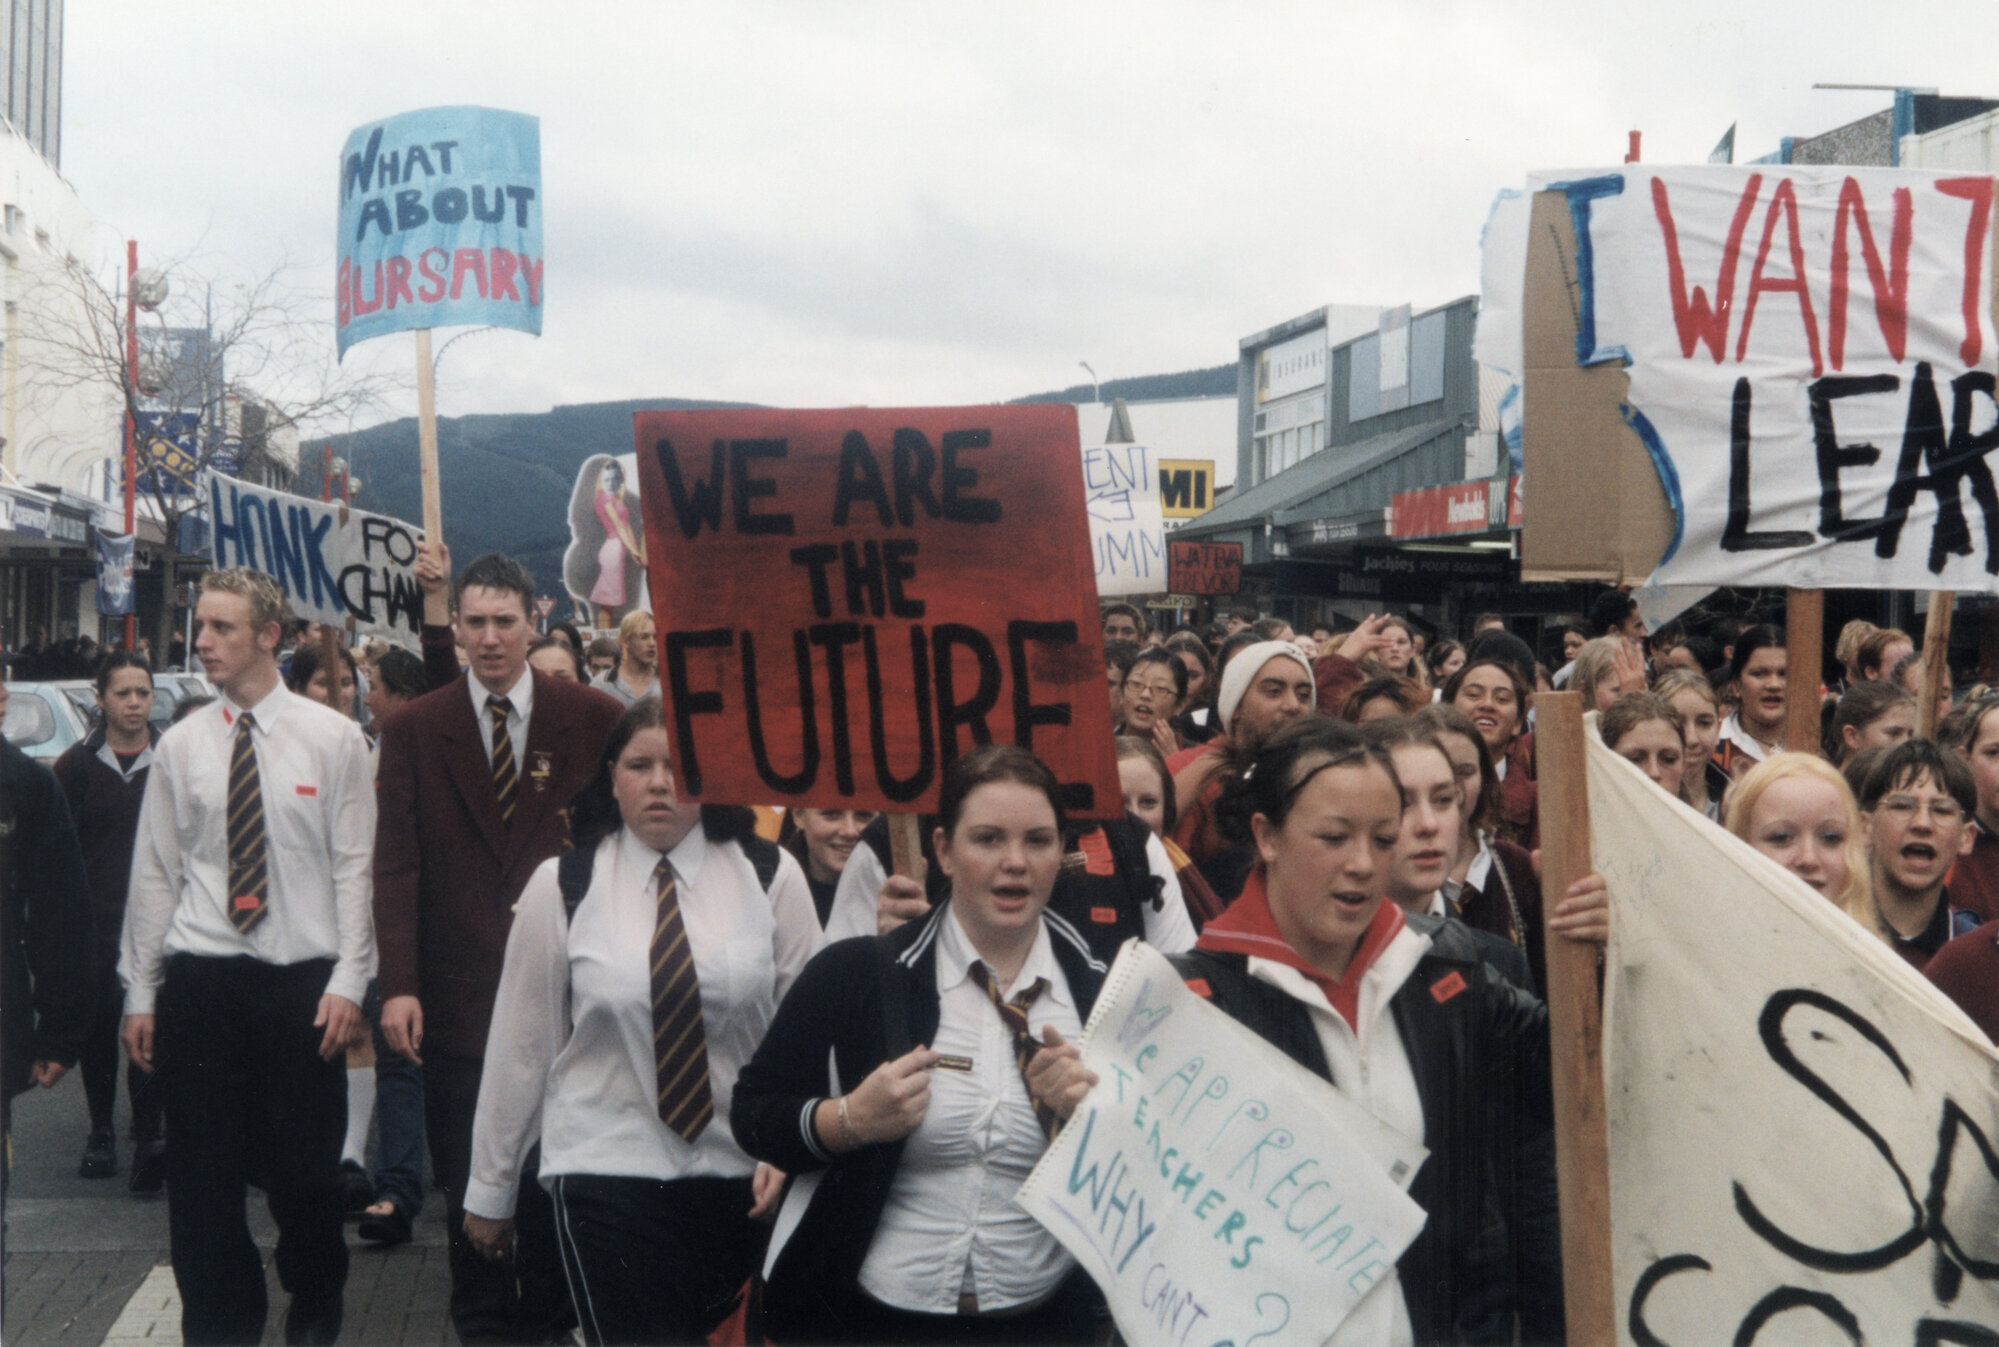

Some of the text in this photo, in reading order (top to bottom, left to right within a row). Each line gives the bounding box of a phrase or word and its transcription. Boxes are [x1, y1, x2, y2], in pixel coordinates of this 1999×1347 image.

[341, 127, 459, 209] WHAT
[356, 184, 535, 243] ABOUT
[337, 247, 545, 330] BURSARY
[1650, 173, 1996, 379] WANT
[211, 476, 345, 614] HONK
[361, 517, 425, 567] FO
[656, 428, 1001, 539] WE ARE
[790, 539, 926, 620] THE
[665, 619, 1095, 821] FUTURE
[1067, 1107, 1209, 1347] WHY CAN'T
[1111, 1063, 1264, 1270] TEACHERS
[1154, 1056, 1391, 1297] APPRECIATE
